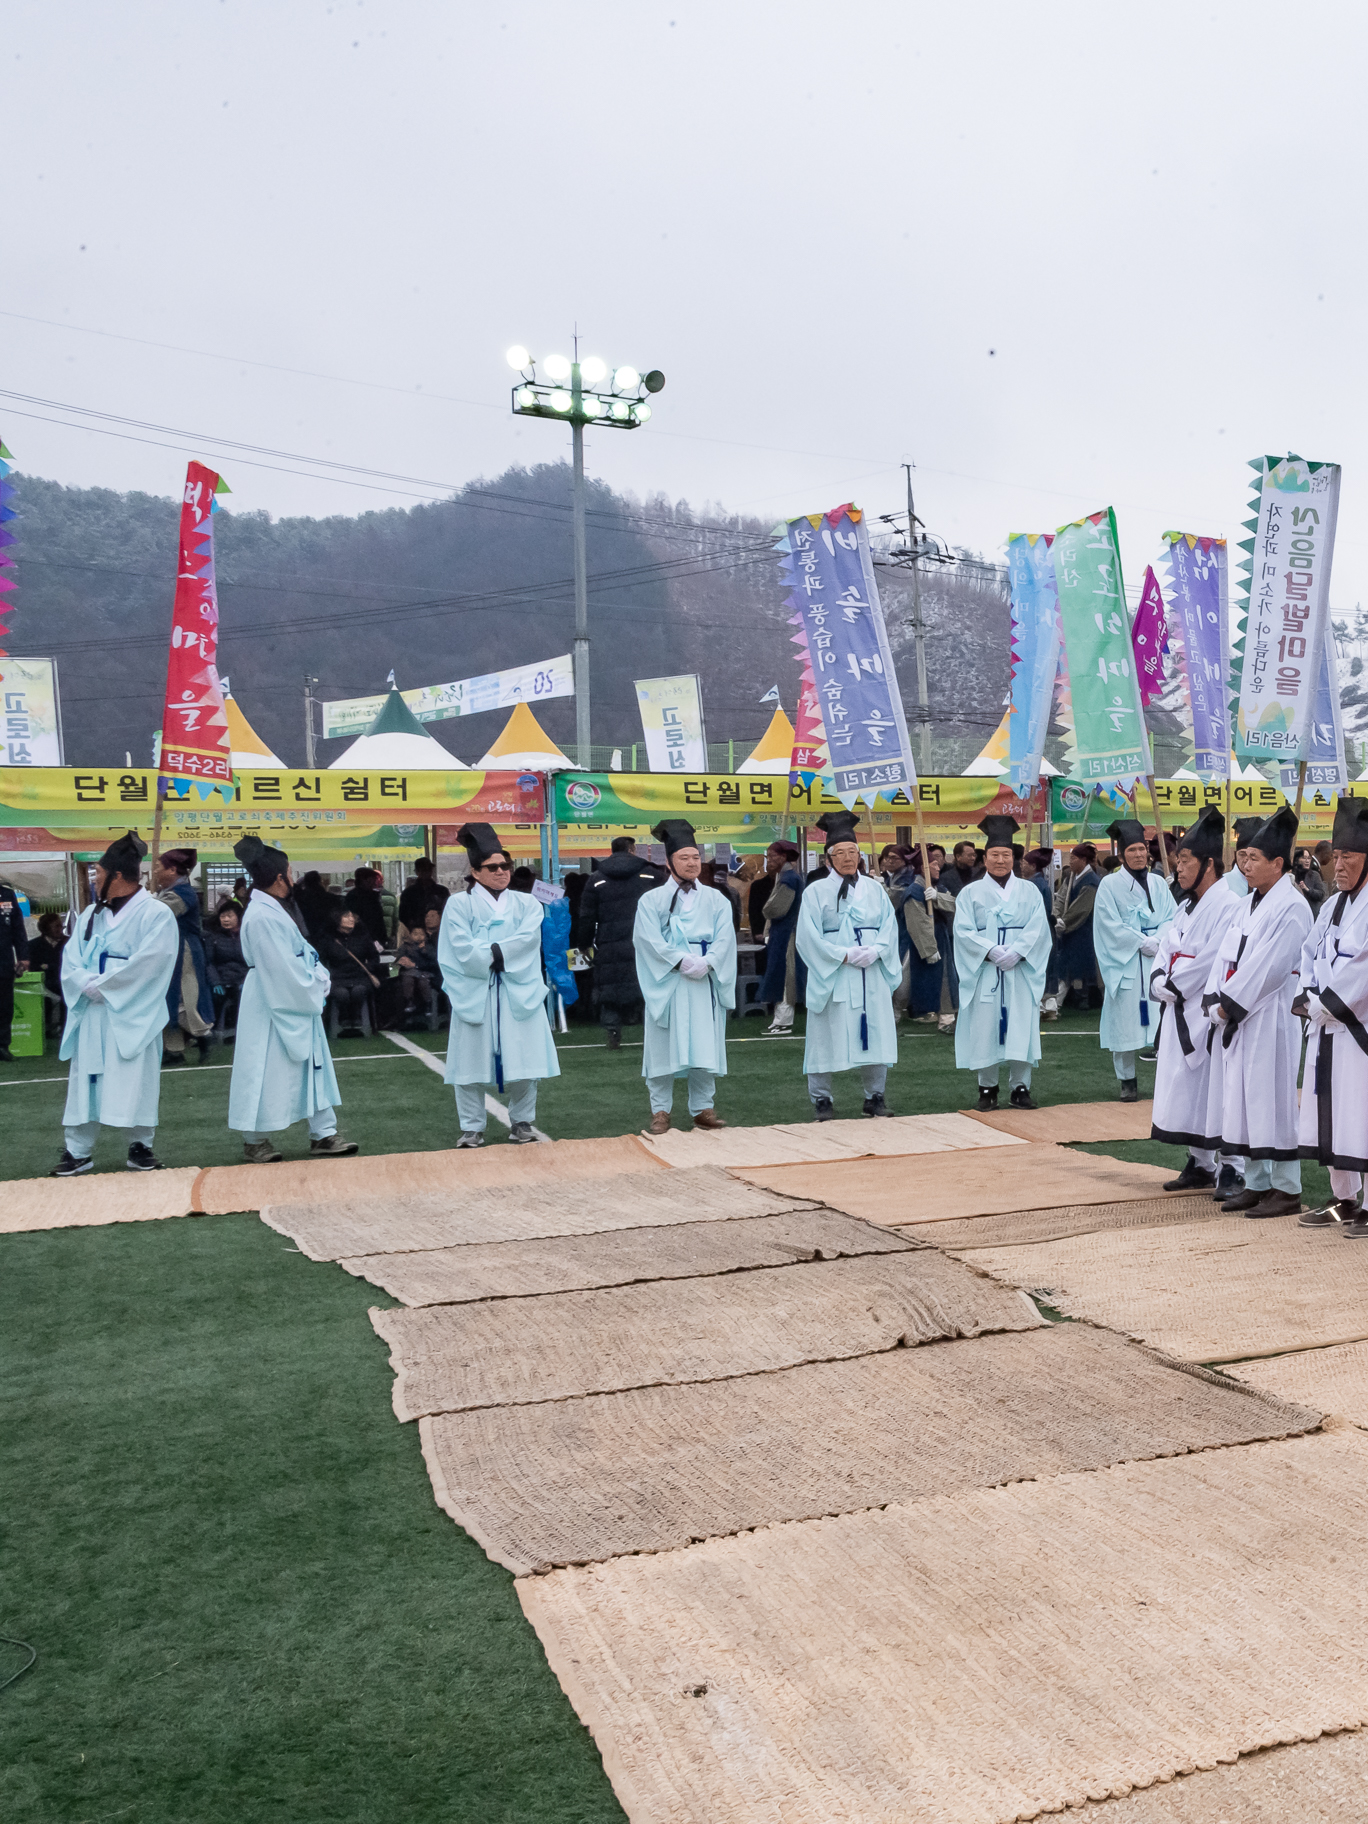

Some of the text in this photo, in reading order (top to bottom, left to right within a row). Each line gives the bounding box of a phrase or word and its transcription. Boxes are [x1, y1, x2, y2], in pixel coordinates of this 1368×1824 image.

[167, 752, 230, 778] 덕수2리
[341, 776, 408, 802] 쉼터
[683, 781, 773, 805] 단월면
[173, 811, 347, 823] 양평단월고로쇠축제추진위원회
